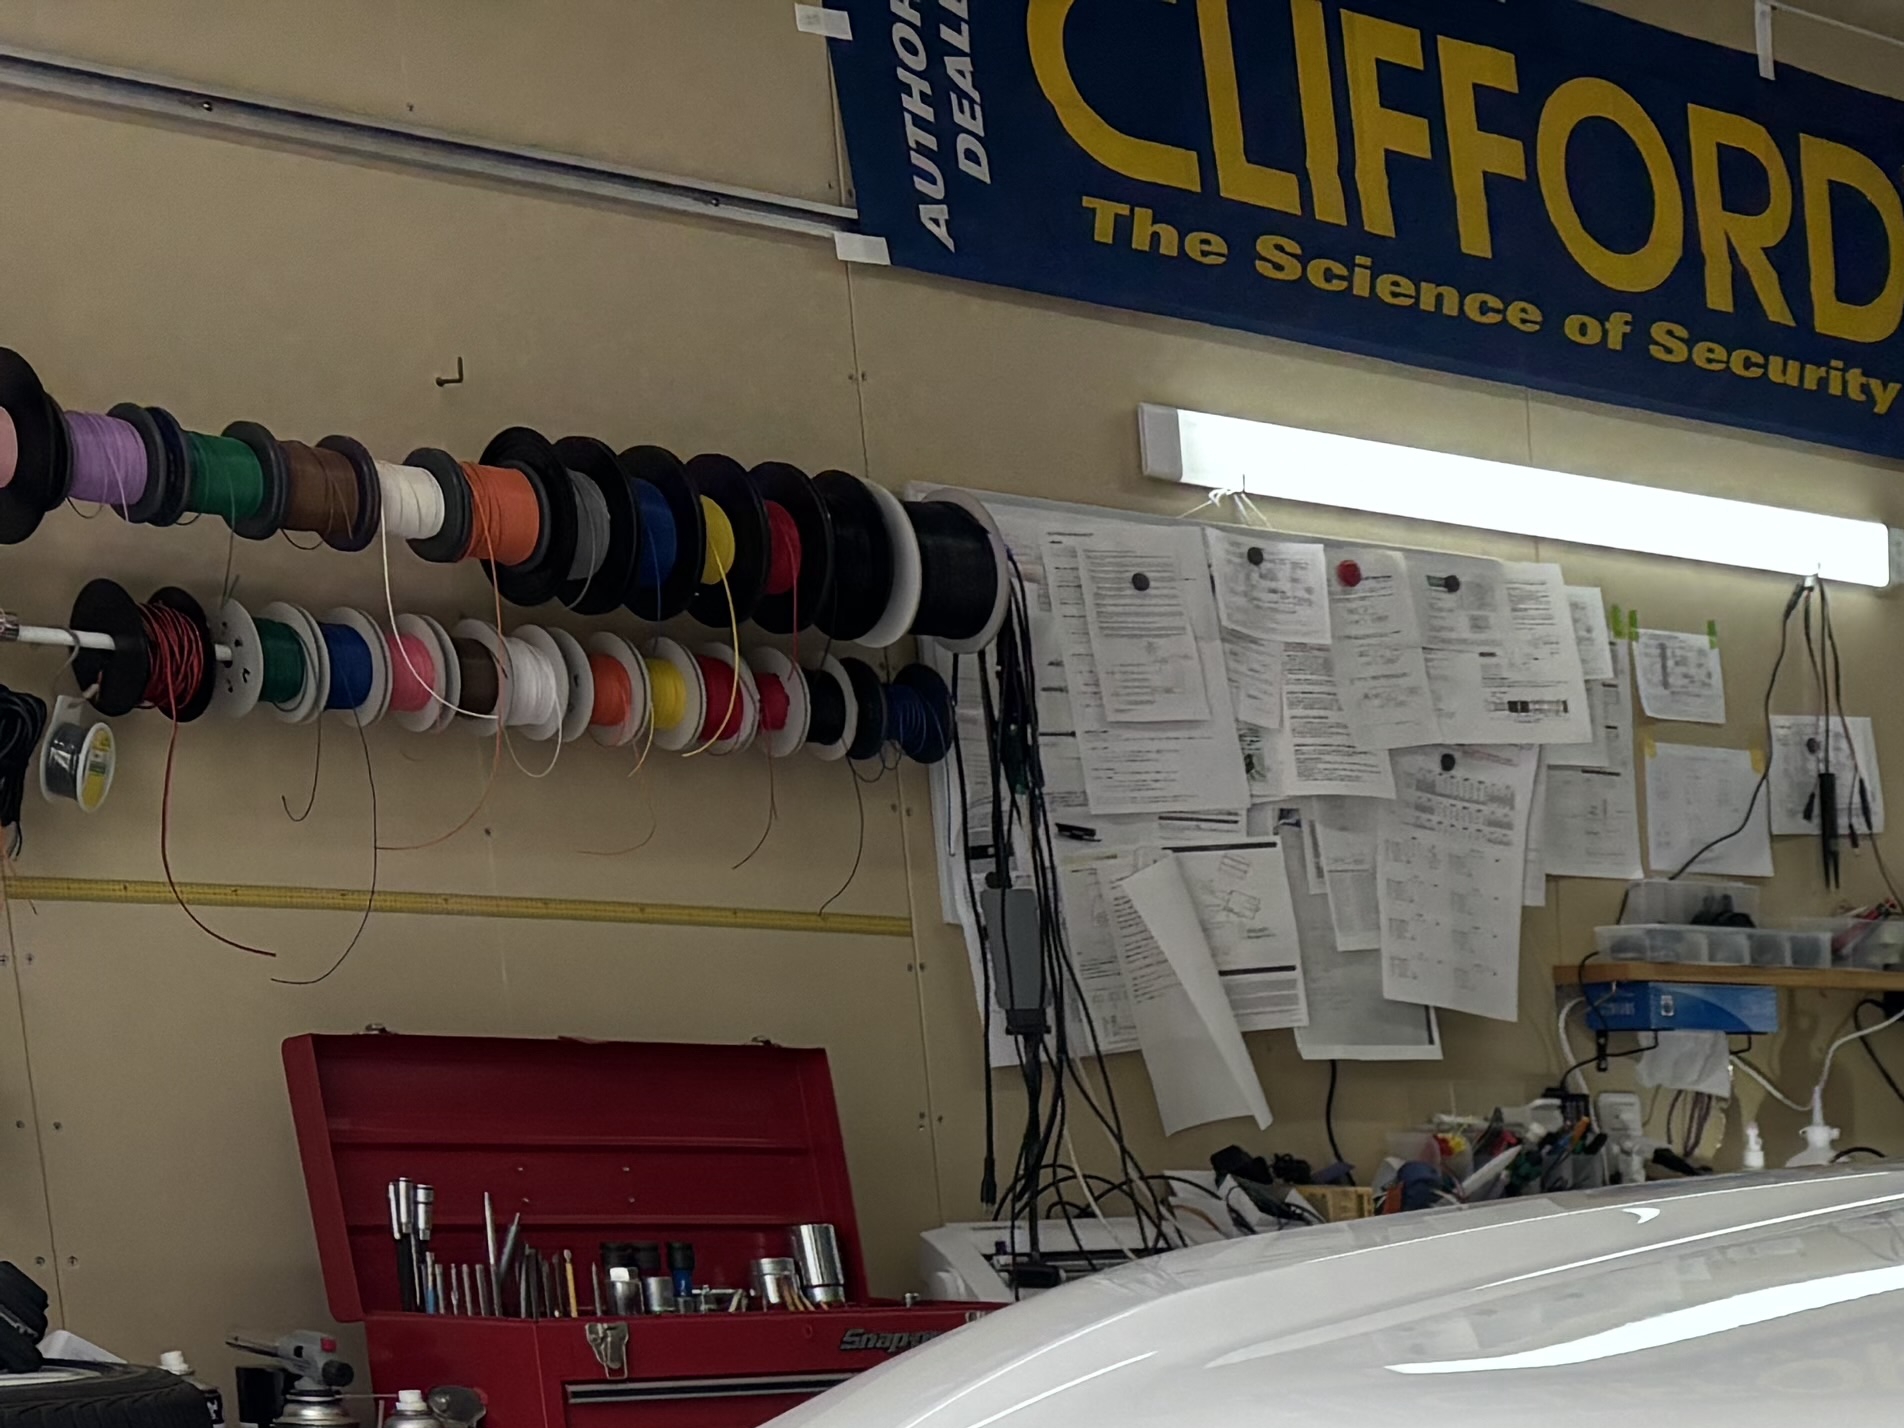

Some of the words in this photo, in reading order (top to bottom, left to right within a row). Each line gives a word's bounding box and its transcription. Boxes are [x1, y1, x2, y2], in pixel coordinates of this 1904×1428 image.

[1080, 194, 1229, 267] The
[1254, 231, 1545, 335] Science
[1563, 311, 1633, 350] of
[1649, 320, 1903, 415] Security
